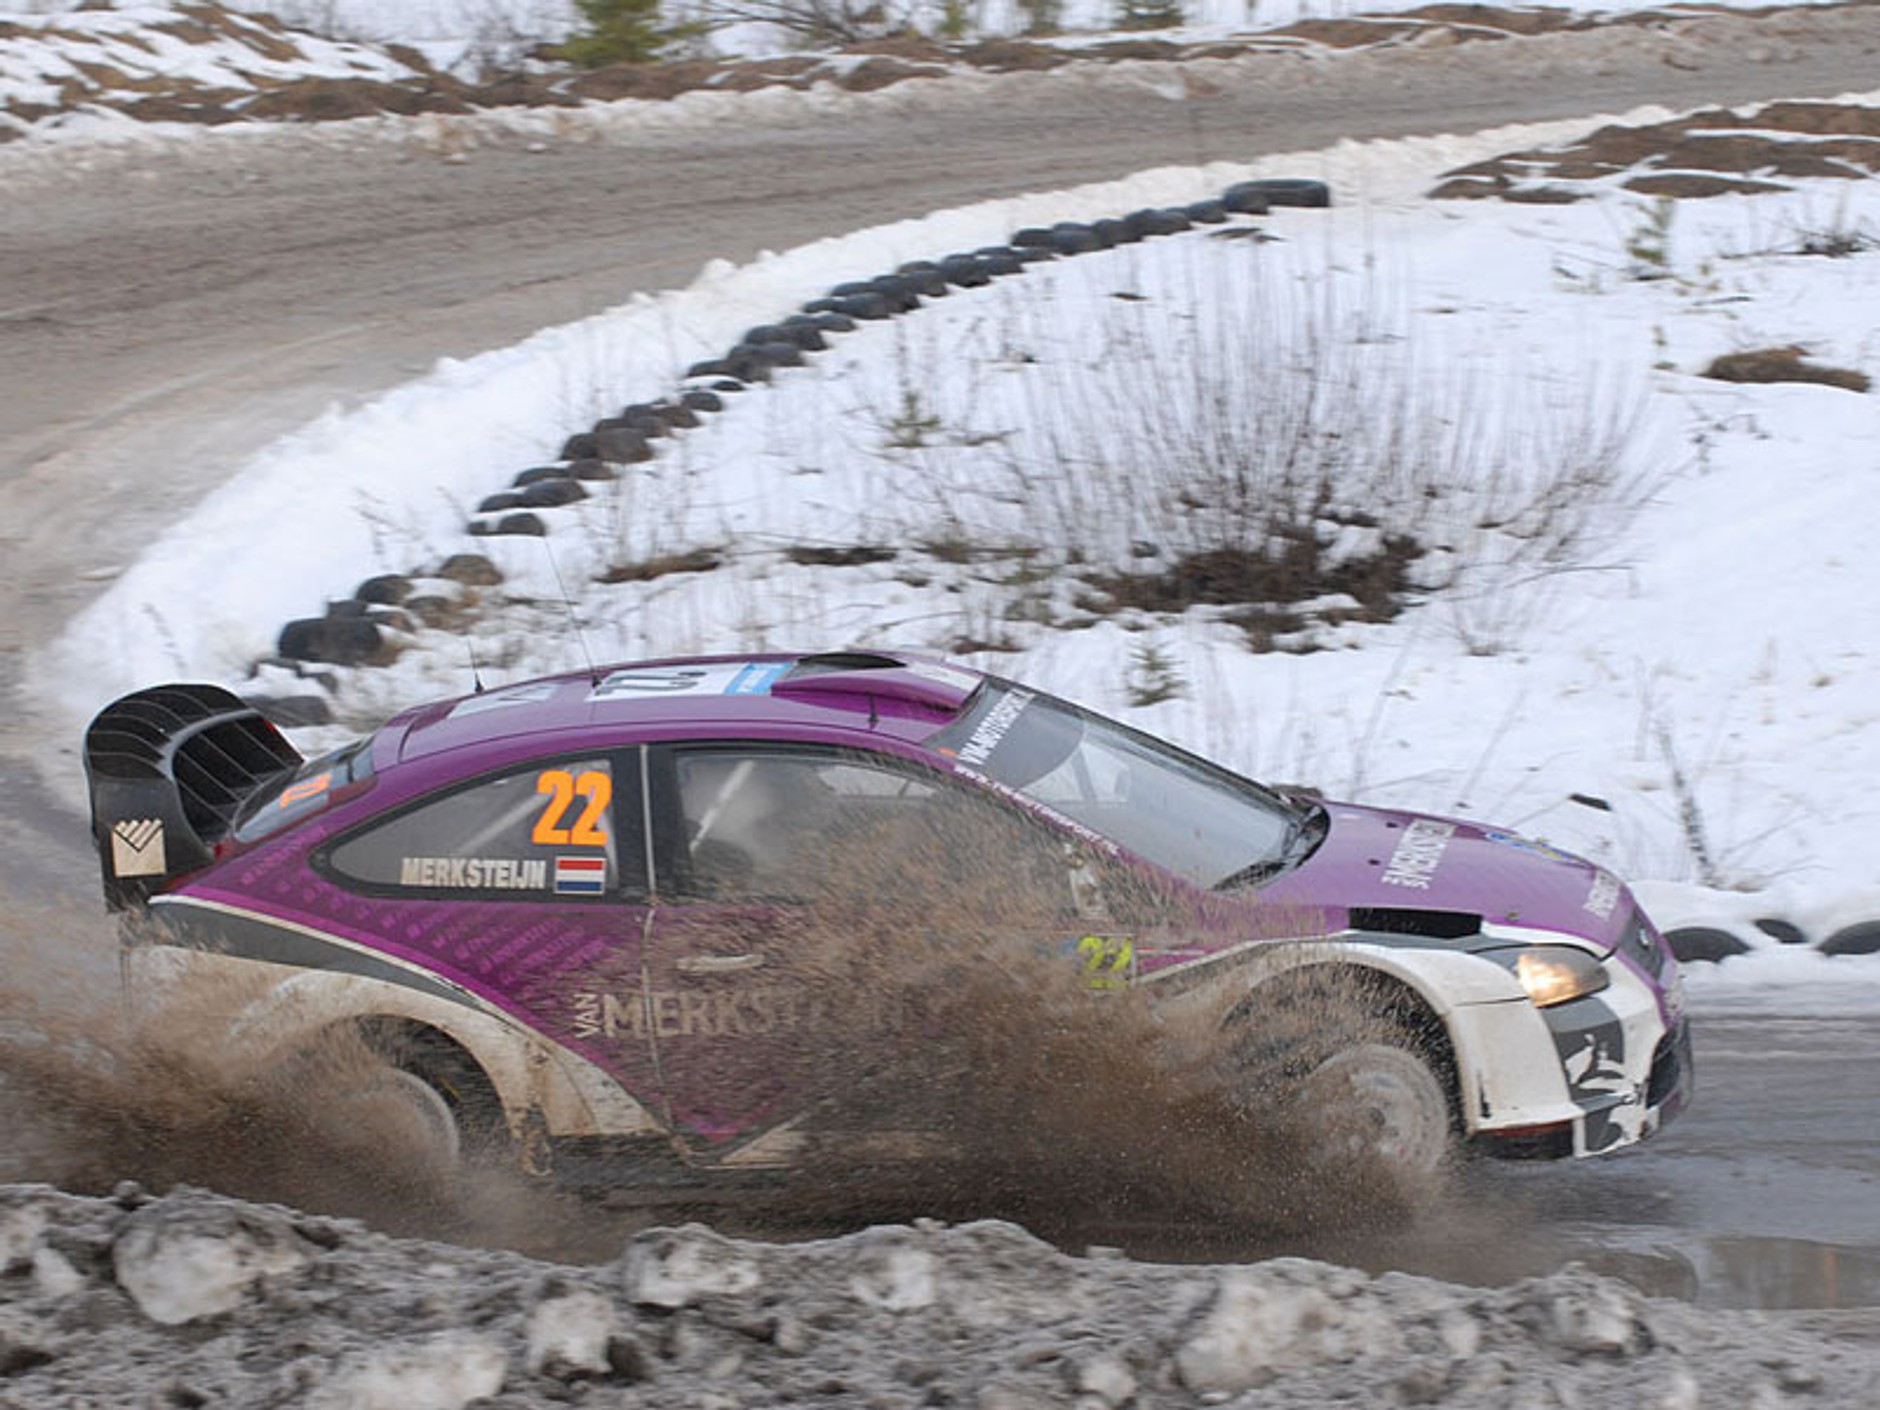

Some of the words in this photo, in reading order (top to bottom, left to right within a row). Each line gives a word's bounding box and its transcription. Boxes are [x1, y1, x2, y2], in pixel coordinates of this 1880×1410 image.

[531, 769, 613, 846] 22
[400, 856, 547, 889] MERKSTEIJN
[1077, 936, 1132, 989] 22
[572, 992, 600, 1039] VAN
